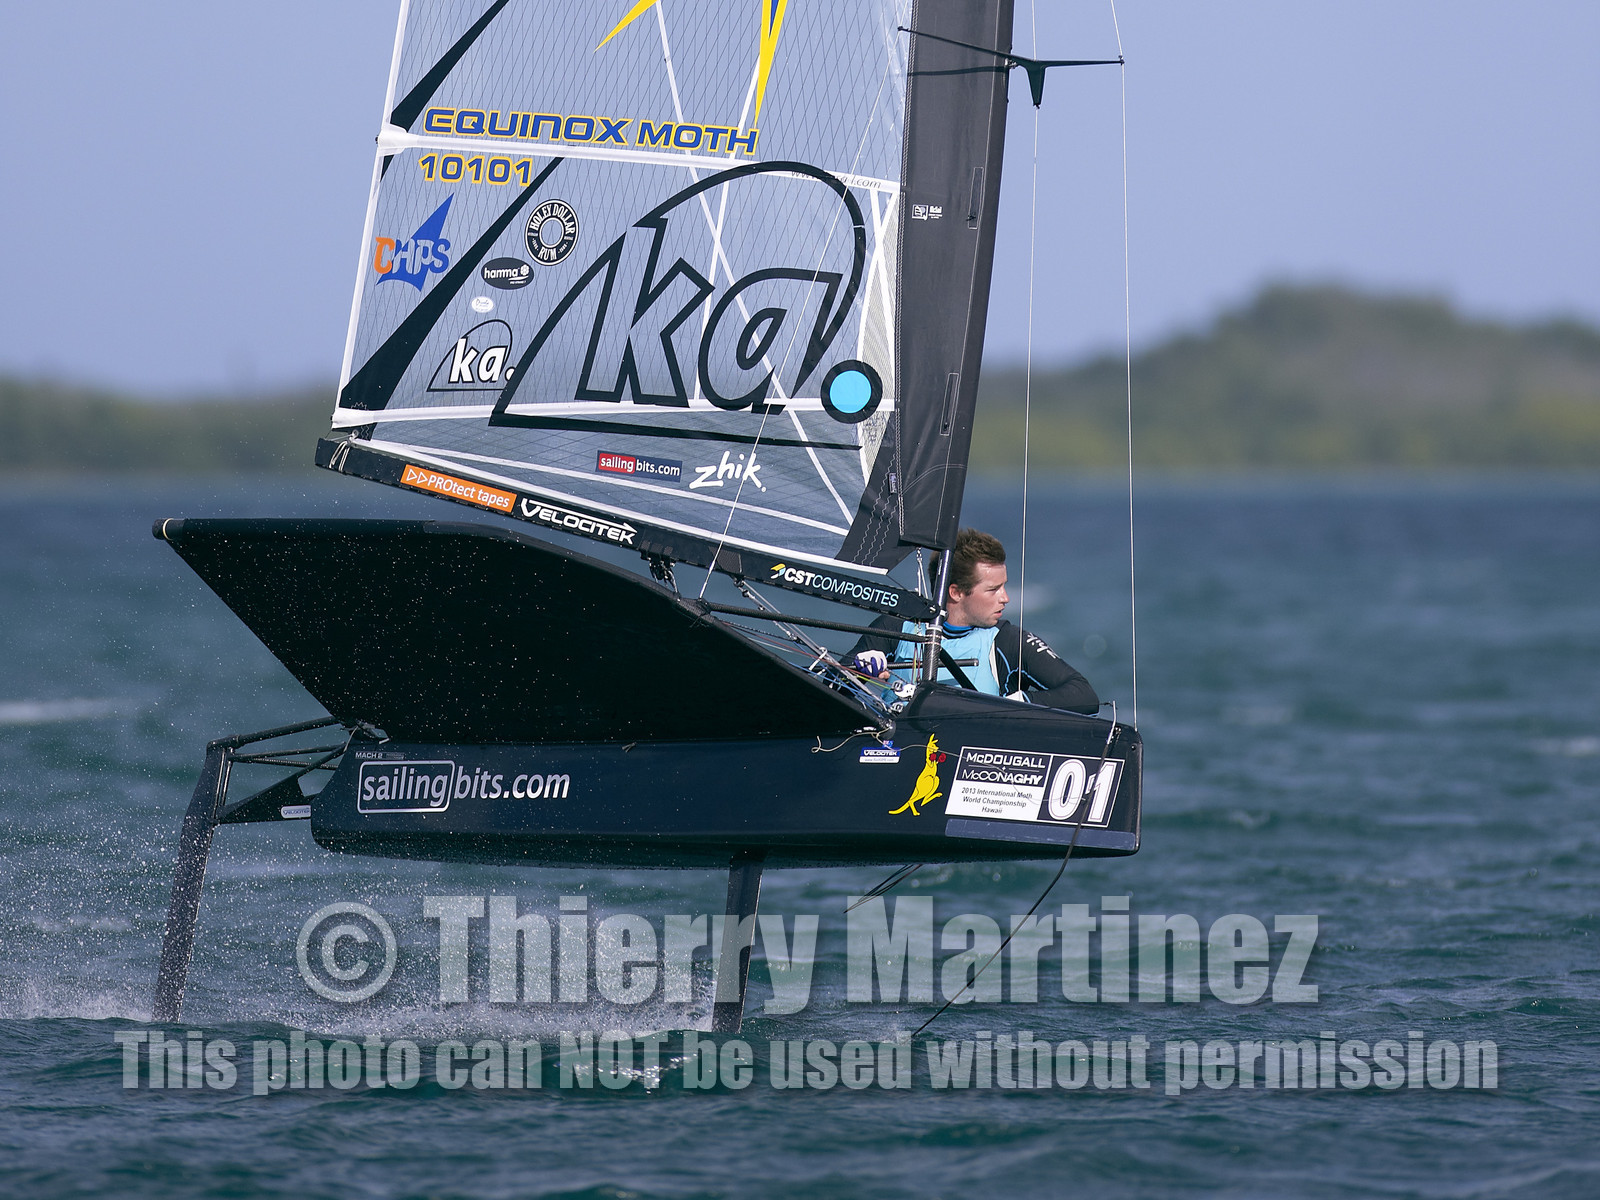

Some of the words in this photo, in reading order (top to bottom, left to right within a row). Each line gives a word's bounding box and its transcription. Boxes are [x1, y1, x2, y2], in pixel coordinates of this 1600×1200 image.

[424, 107, 632, 145] EQUINOX
[635, 120, 760, 156] MOTH
[418, 152, 533, 187] 10101
[529, 204, 552, 231] HOLEY
[551, 203, 576, 235] DOLLAR
[537, 246, 557, 261] RUM
[427, 474, 475, 499] PROtect
[477, 488, 510, 510] tapes
[520, 498, 637, 545] VELOCITEK
[961, 787, 976, 795] 2013
[977, 788, 1016, 798] International
[1017, 791, 1033, 799] Moth
[963, 796, 981, 804] World
[982, 797, 1027, 808] Championship
[1048, 758, 1118, 823] 01
[981, 806, 1003, 814] Hawaii
